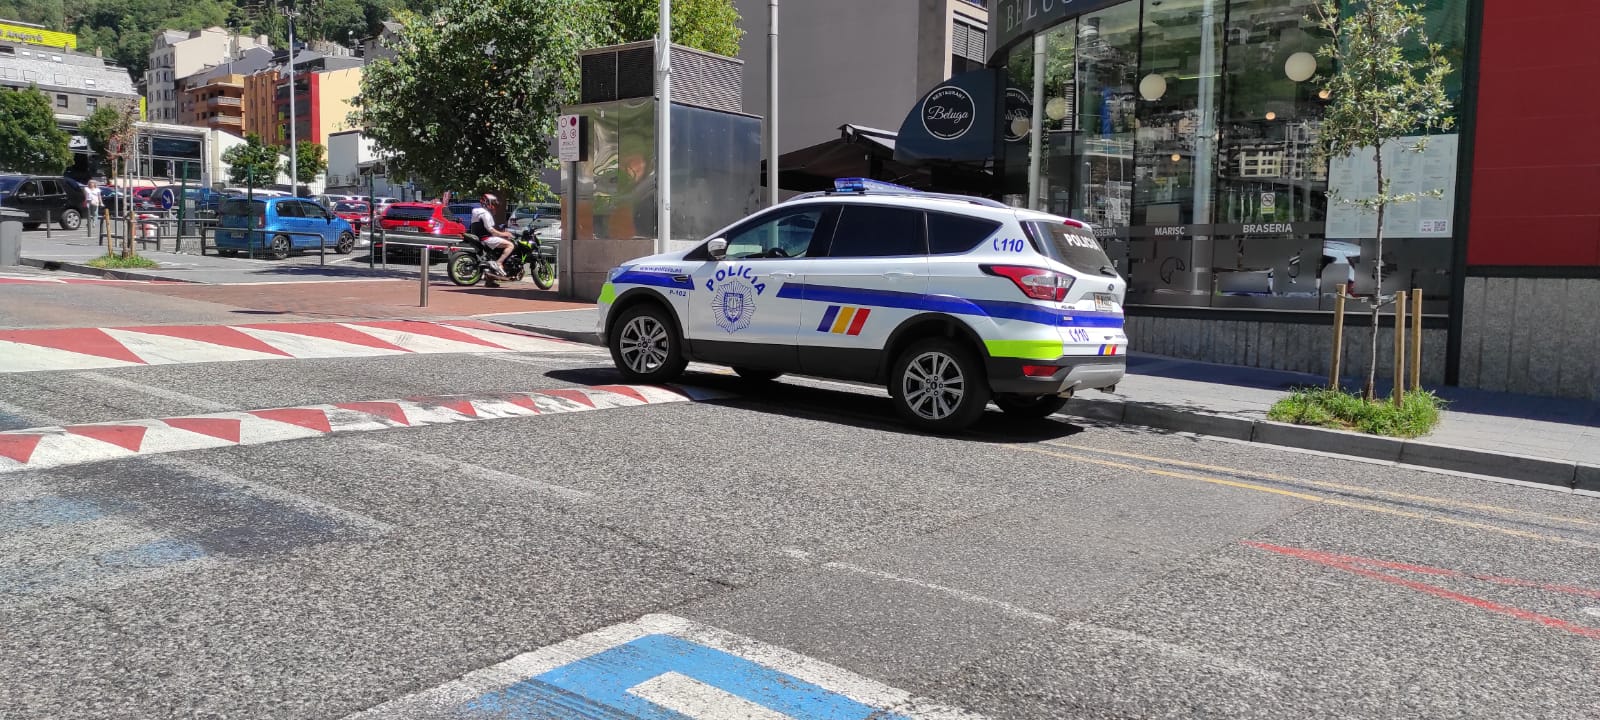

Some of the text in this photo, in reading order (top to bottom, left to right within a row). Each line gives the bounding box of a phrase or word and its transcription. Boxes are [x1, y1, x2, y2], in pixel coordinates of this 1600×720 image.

[1006, 0, 1072, 32] BELU
[932, 90, 966, 101] RESTAURANT
[927, 105, 969, 124] Beluga
[1155, 226, 1185, 236] MARISC
[1242, 223, 1293, 233] BRASERIA
[1001, 238, 1024, 253] 110
[706, 265, 766, 296] POLICIA
[669, 289, 687, 297] P-102
